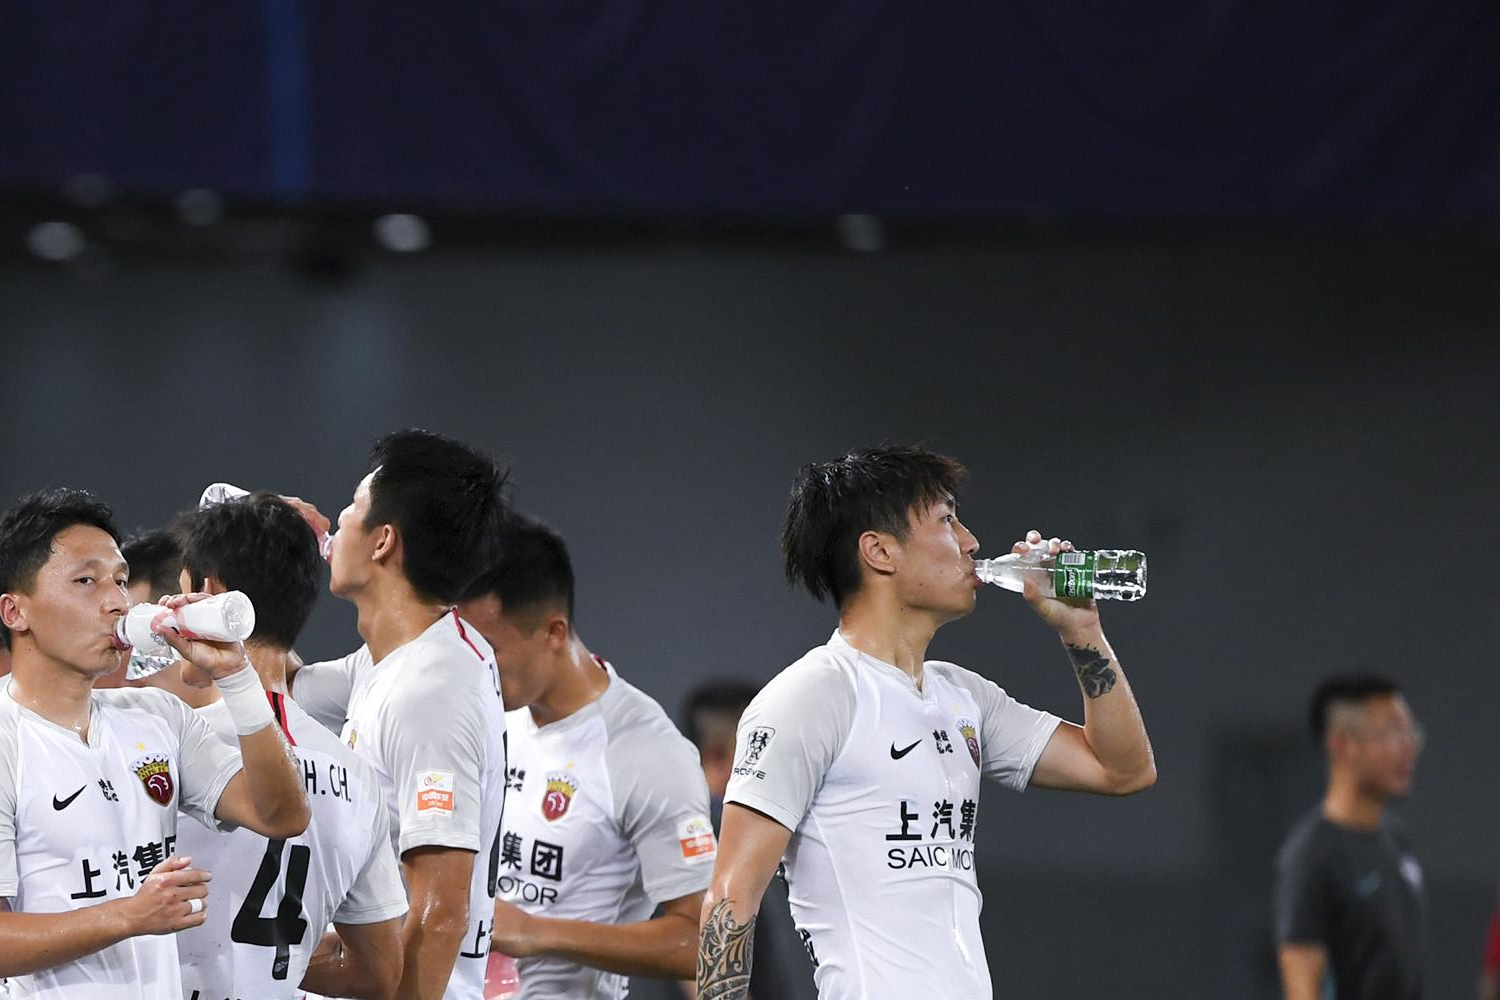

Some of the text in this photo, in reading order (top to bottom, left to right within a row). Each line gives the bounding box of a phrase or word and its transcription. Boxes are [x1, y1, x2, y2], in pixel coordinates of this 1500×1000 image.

[296, 758, 352, 803] H.CH.
[885, 798, 976, 843] 上汽集
[500, 830, 564, 882] 集团
[887, 846, 948, 870] SAIC
[231, 838, 311, 980] 4
